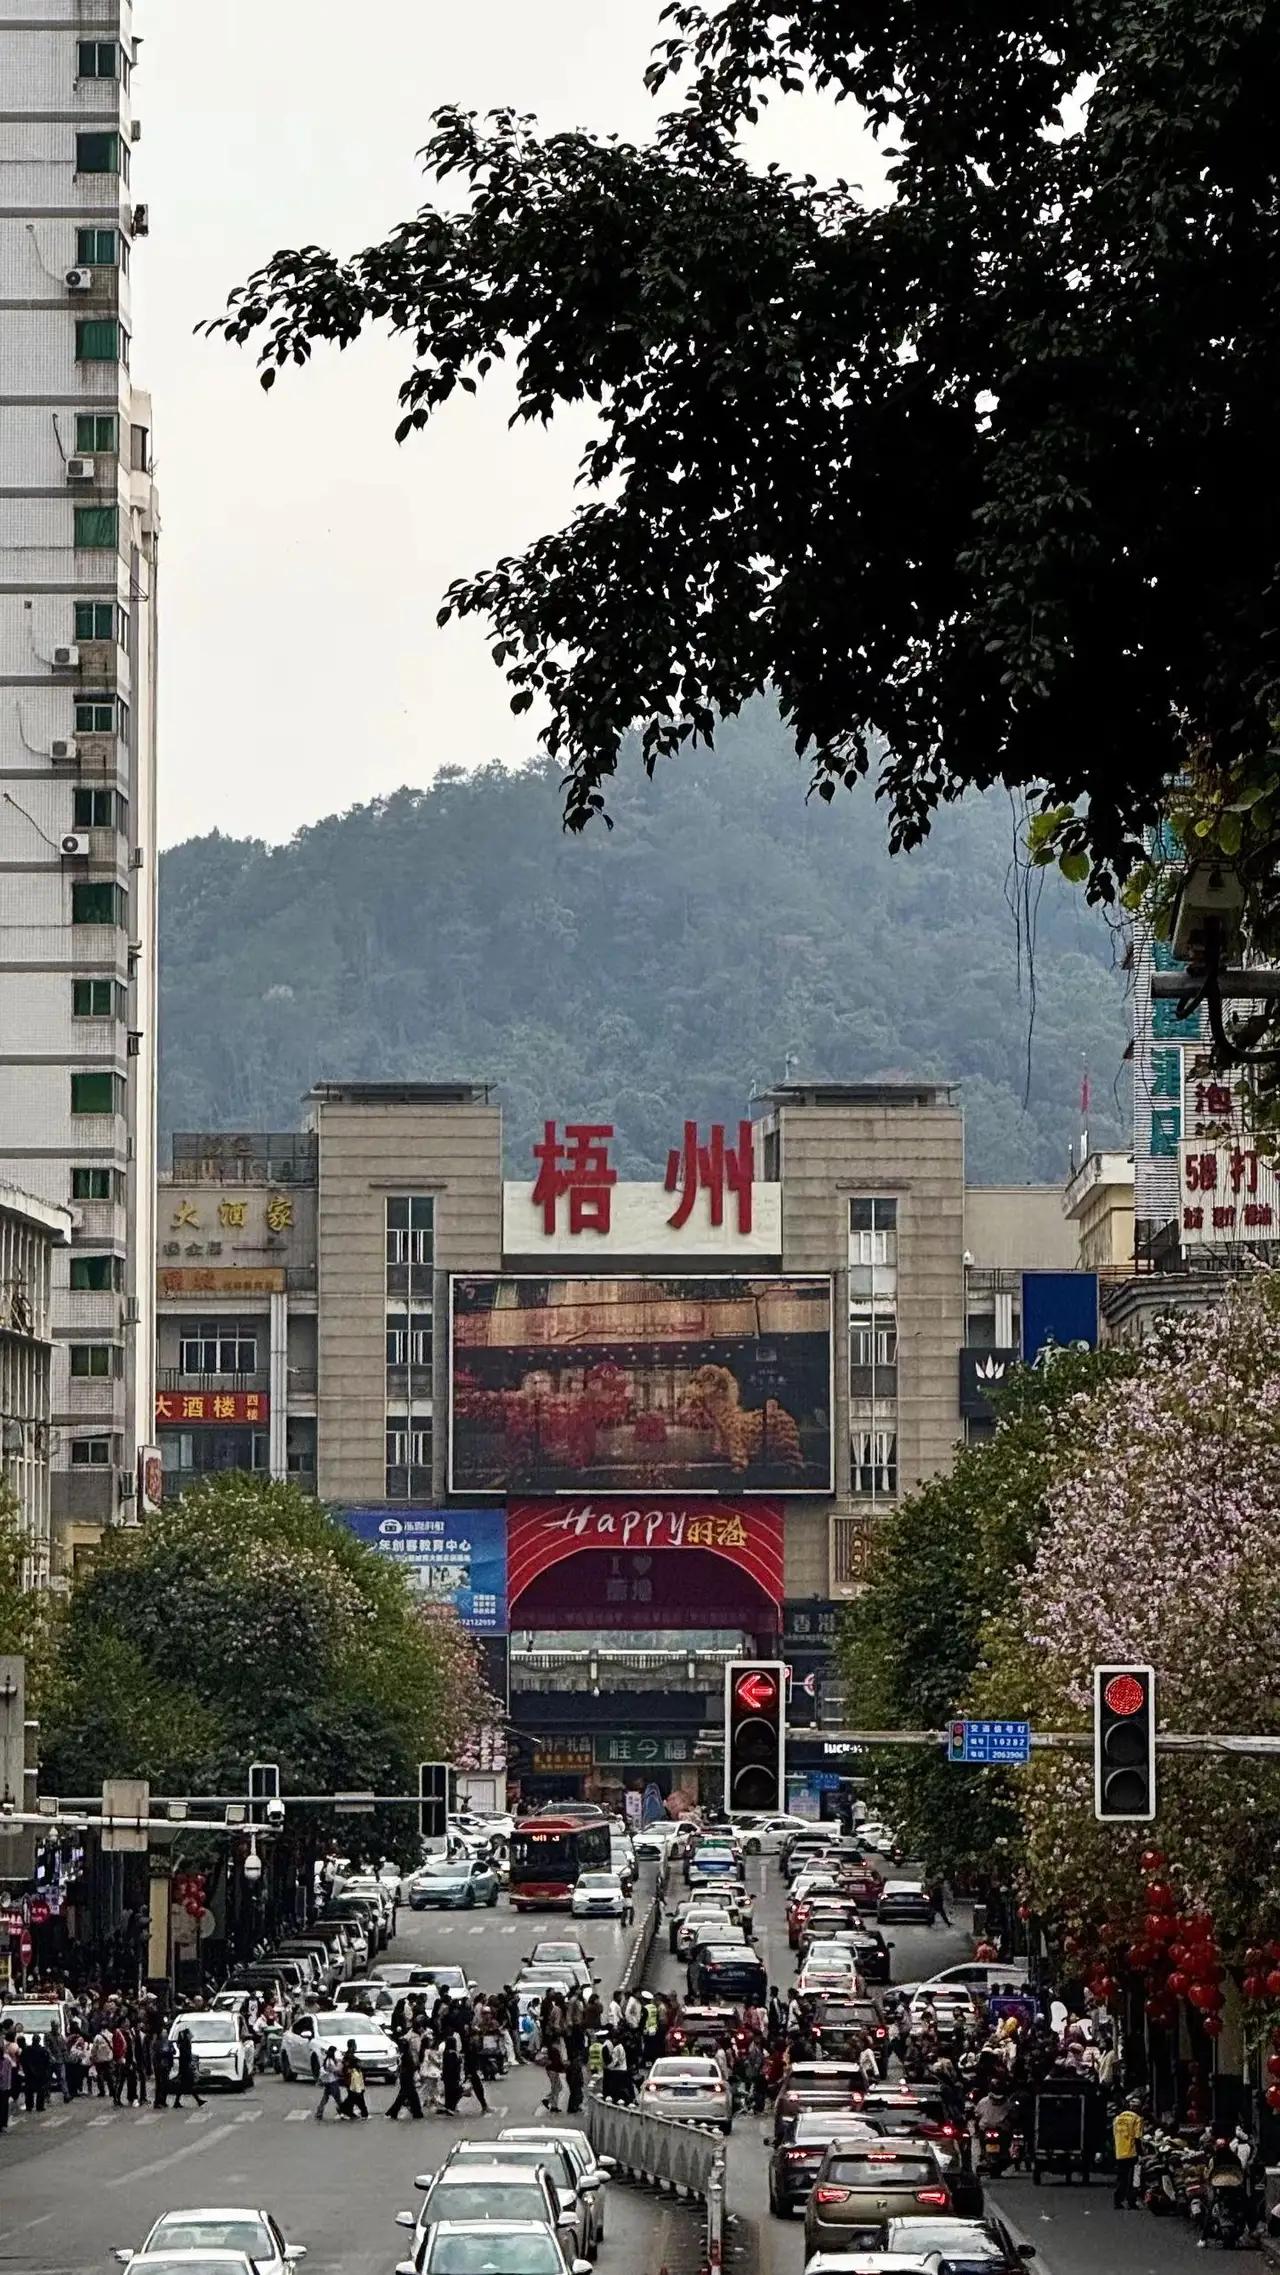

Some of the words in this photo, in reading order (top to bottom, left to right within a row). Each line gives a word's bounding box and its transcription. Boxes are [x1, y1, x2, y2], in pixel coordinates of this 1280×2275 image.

[532, 1120, 755, 1235] 梧州
[170, 1196, 294, 1232] 大酒家
[971, 1725, 1025, 1733] 交通信号灯
[609, 1739, 687, 1760] 桂今福
[993, 1738, 1025, 1746] 10282
